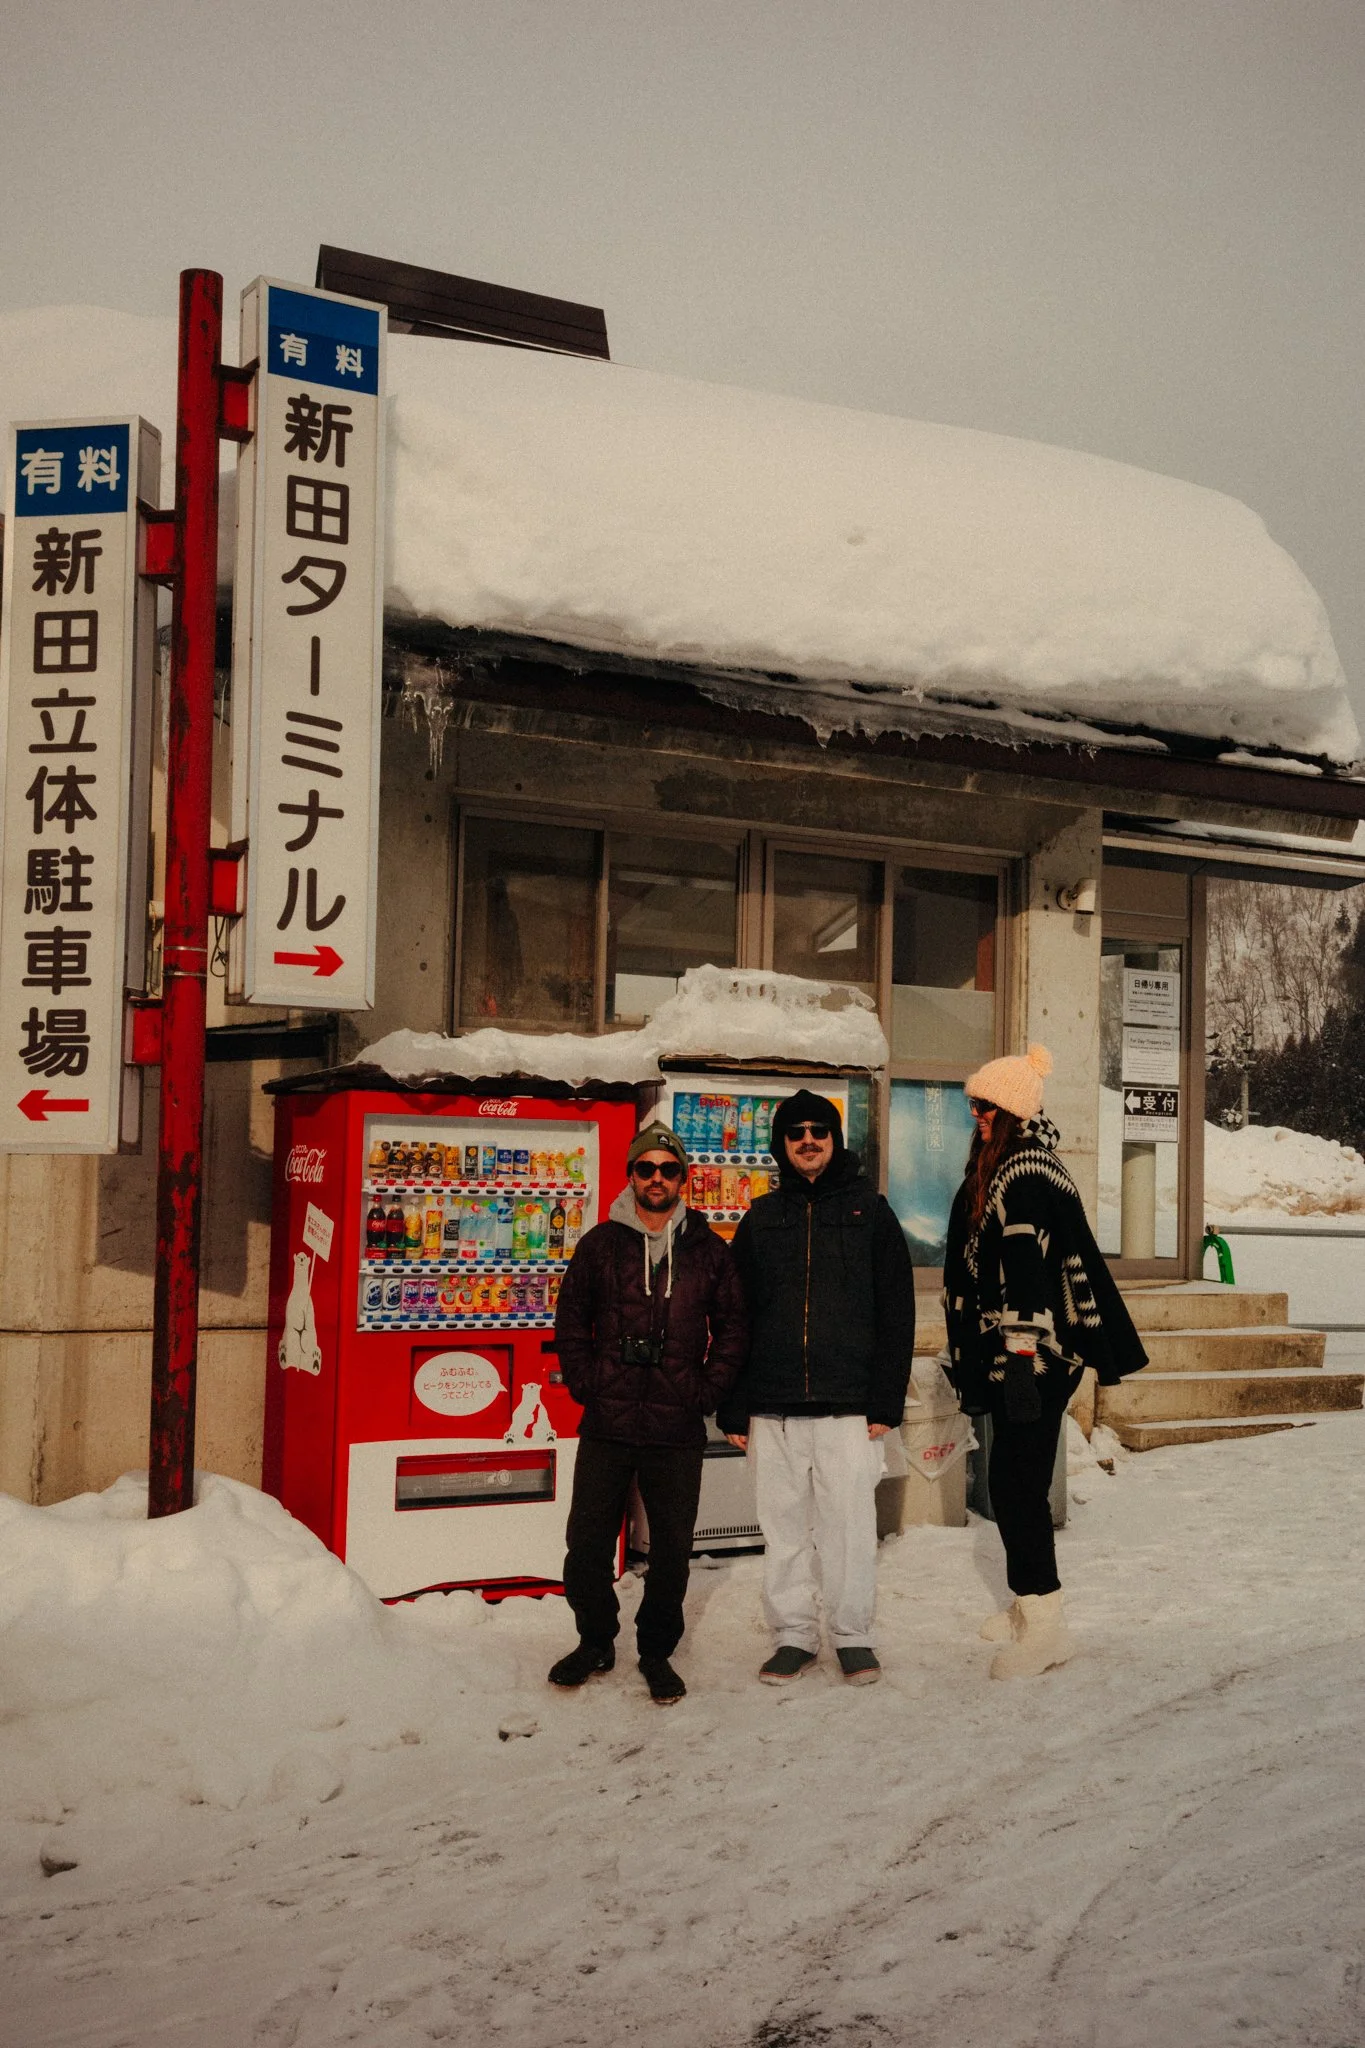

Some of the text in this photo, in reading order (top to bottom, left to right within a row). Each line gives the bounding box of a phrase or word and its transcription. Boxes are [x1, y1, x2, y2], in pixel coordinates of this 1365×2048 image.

[279, 333, 364, 379] 有料
[20, 445, 121, 496] 有料
[276, 392, 354, 932] 新田ターミナル
[19, 527, 103, 1078] 新田立体駐車場
[478, 1100, 519, 1116] Coca-Cola
[699, 1096, 731, 1109] DyDo
[1142, 1096, 1176, 1112] 受付
[285, 1147, 327, 1183] Coca-Cola
